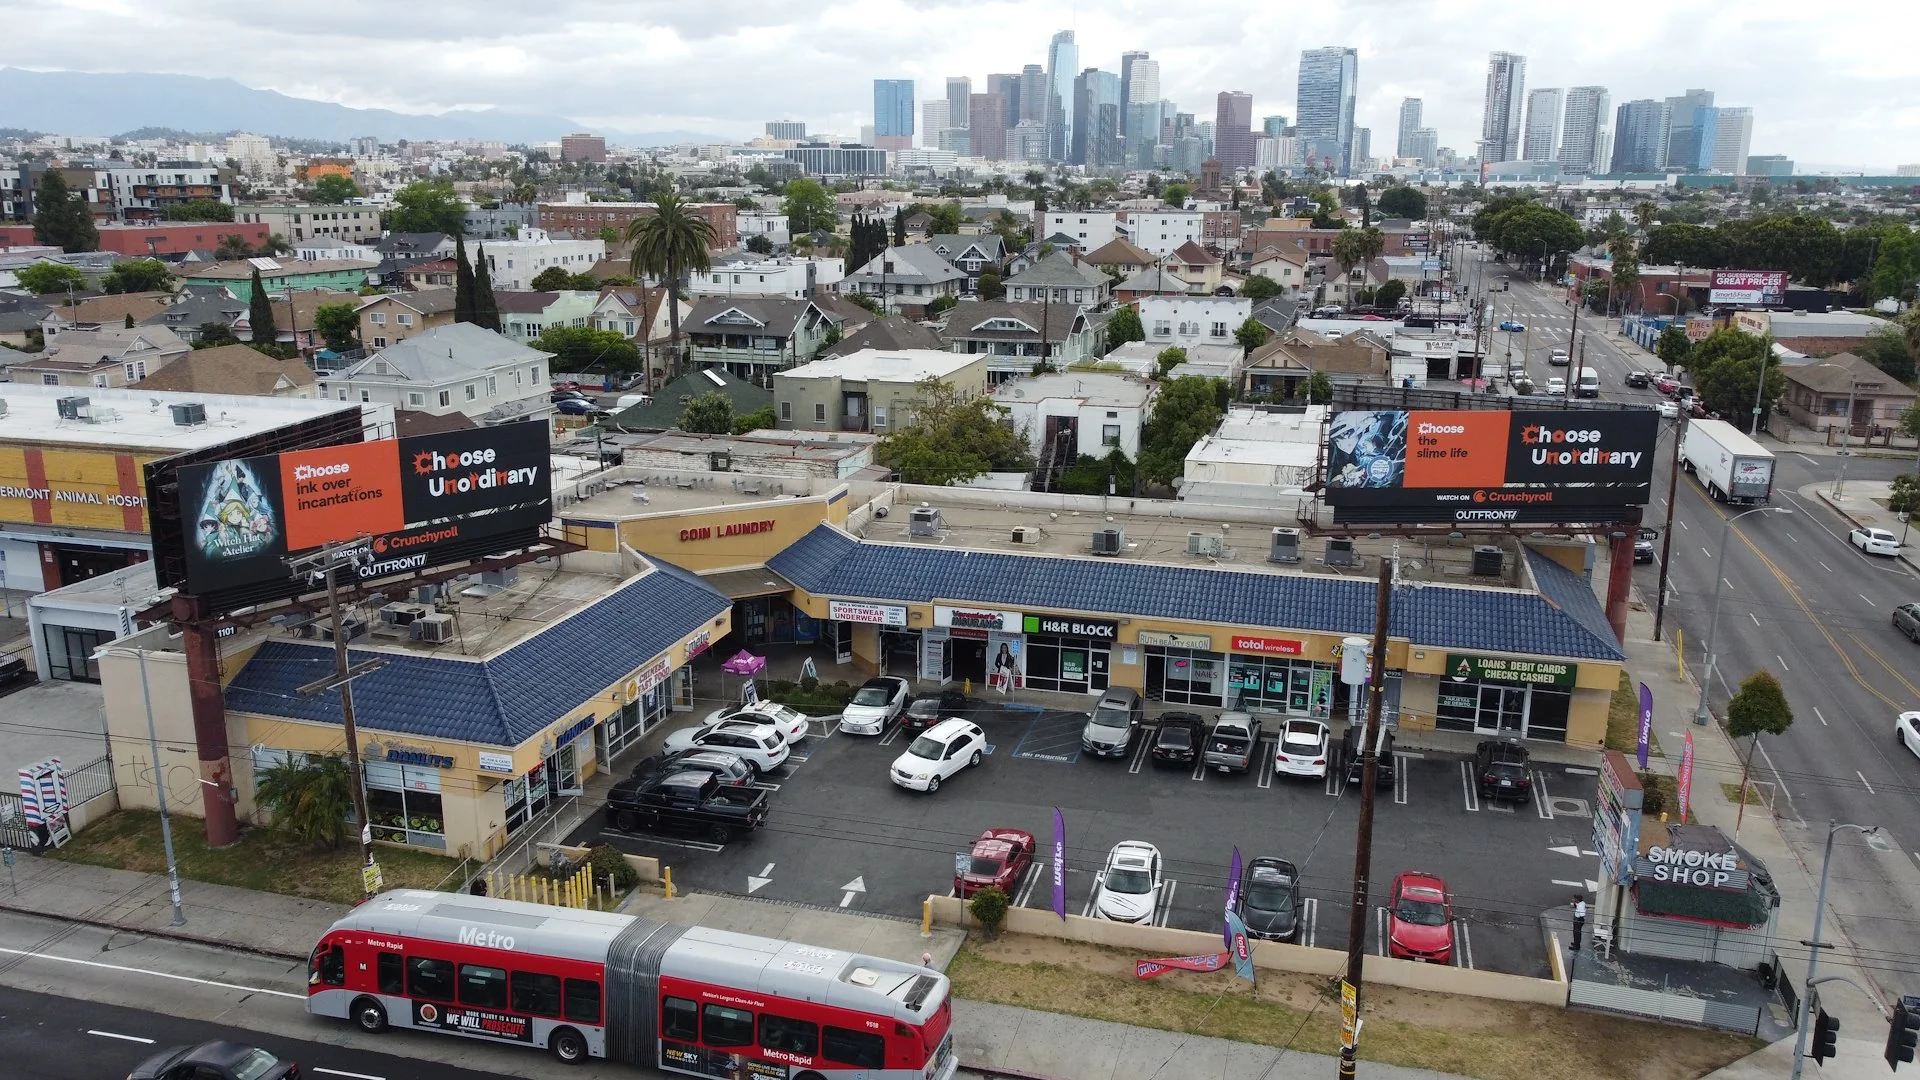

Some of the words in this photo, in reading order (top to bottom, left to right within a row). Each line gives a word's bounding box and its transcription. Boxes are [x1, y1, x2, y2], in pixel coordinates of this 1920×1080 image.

[1747, 278, 1782, 286] PRICES!
[1417, 421, 1465, 436] Choose
[1521, 424, 1601, 445] Choose
[1418, 436, 1437, 446] the
[1417, 447, 1448, 459] slime
[1450, 447, 1468, 459] life
[1531, 447, 1642, 469] Unordinary
[413, 448, 496, 475] Choose
[294, 462, 350, 482] Choose
[296, 481, 318, 495] ink
[322, 477, 352, 491] over
[428, 466, 538, 497] Unordinary
[55, 491, 103, 505] ANIMAL
[298, 486, 383, 511] incantations
[1488, 491, 1553, 503] Crunchyroll
[390, 527, 459, 550] Crunchyroll
[680, 527, 711, 542] COIN
[717, 520, 776, 538] LAUNDRY
[214, 535, 241, 548] Witch
[222, 545, 254, 557] Atelier
[833, 606, 885, 616] SPORTSWEAR
[835, 613, 883, 623] UNDERWEAR
[952, 617, 1003, 629] INSURANCE
[1042, 621, 1069, 633] H&R
[1072, 624, 1113, 637] BLOCK
[217, 627, 235, 638] 1101
[1140, 635, 1158, 645] RUTH
[1186, 640, 1209, 649] SALON
[1237, 639, 1264, 650] total
[1264, 645, 1295, 653] wireless
[639, 659, 666, 683] CHINESE
[1194, 670, 1218, 679] NAILS
[1478, 659, 1506, 669] LOANS
[1511, 661, 1535, 672] DEBIT
[1537, 663, 1567, 675] CARDS
[638, 678, 652, 695] FAST
[654, 666, 670, 683] FOOD
[1485, 669, 1519, 681] CHECKS
[1520, 672, 1555, 684] CASHED
[1648, 846, 1737, 872] SMOKE
[1653, 864, 1730, 888] SHOP
[367, 939, 385, 947] Metro
[386, 941, 403, 950] Rapid
[458, 926, 516, 950] Metro
[1238, 936, 1248, 957] total
[466, 1010, 479, 1018] WORK
[480, 1012, 498, 1021] INJURY
[446, 1013, 459, 1025] WE
[460, 1015, 480, 1028] WILL
[481, 1019, 525, 1035] PROSECUTE
[666, 1048, 683, 1057] NEW
[683, 1052, 698, 1061] SKY
[763, 1048, 789, 1060] Metro
[789, 1053, 812, 1066] Rapid
